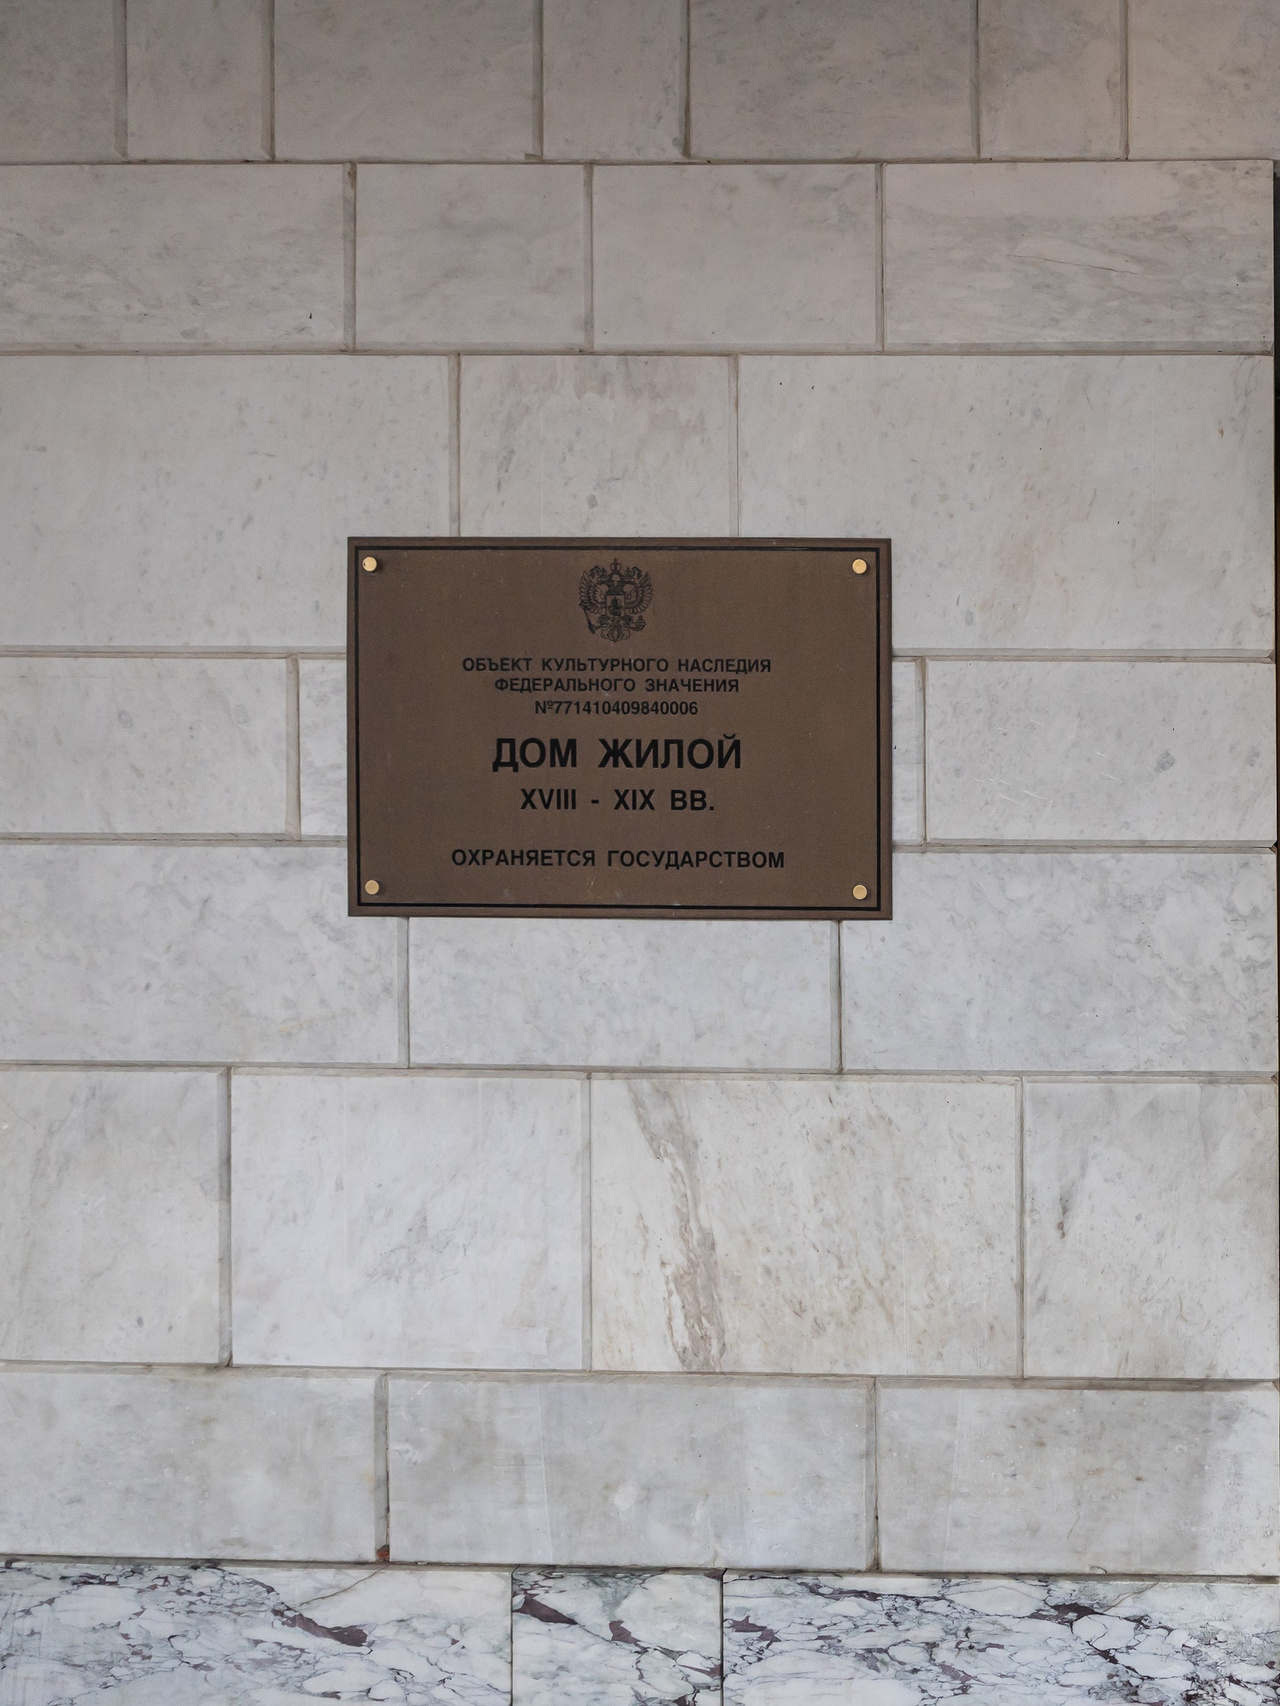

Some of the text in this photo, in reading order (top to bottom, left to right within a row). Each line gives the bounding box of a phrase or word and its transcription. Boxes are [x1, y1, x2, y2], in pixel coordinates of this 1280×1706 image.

[462, 657, 772, 674] ОБЪЕКТ КУЛЬТУРНОГО НАСЛЕДИЯ
[494, 678, 739, 693] ФЕДЕРАЛЬНОГО ЗНАЧЕНИЯ
[534, 699, 698, 716] №771410409840006
[492, 733, 742, 772] ДОМ ЖИЛОЙ
[520, 788, 577, 810] XVIII
[614, 789, 655, 811] XIX
[670, 789, 715, 811] ВВ.
[451, 849, 785, 870] ОХРАНЯЕТСЯ ГОСУДАРСТВОМ
